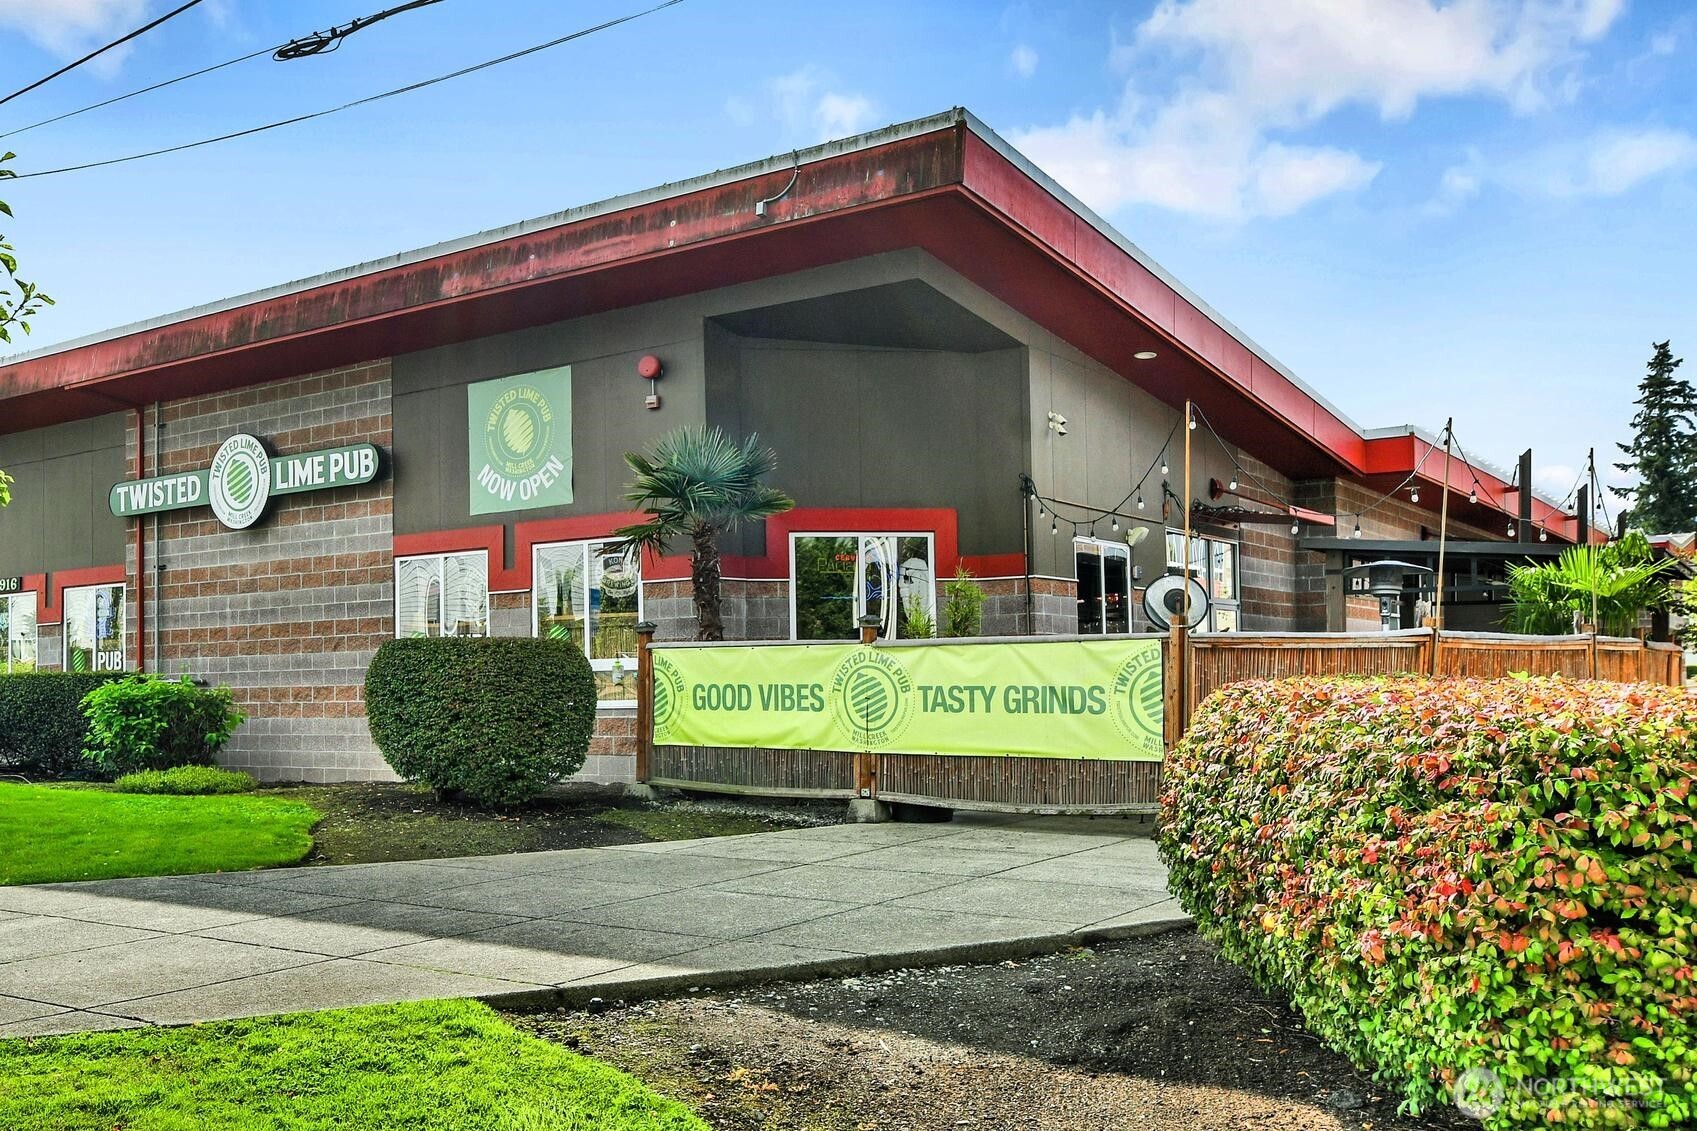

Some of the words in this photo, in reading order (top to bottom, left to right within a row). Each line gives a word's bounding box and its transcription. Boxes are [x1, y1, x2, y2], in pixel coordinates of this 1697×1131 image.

[487, 390, 517, 433] TWISTED
[518, 387, 540, 404] LIME
[537, 398, 552, 423] PUB
[212, 439, 239, 481] TWISTED
[240, 438, 259, 455] LIME
[256, 452, 268, 475] PUB
[275, 455, 325, 490] LIME
[329, 448, 375, 483] PUB
[476, 463, 517, 501] NOW
[519, 454, 565, 501] OPEN
[116, 475, 201, 512] TWISTED
[835, 553, 858, 561] CERV
[0, 577, 17, 591] 916
[97, 650, 123, 671] PUB
[654, 655, 672, 672] LIME
[671, 669, 685, 693] PUB
[832, 651, 866, 694] TWISTED
[868, 651, 896, 671] LIME
[892, 667, 911, 694] PUB
[1113, 648, 1161, 695] TWISTED
[692, 683, 752, 711] GOOD
[758, 683, 825, 713] VIBES
[917, 685, 997, 713] TASTY
[1003, 685, 1107, 715] GRINDS
[1144, 735, 1163, 747] MILL
